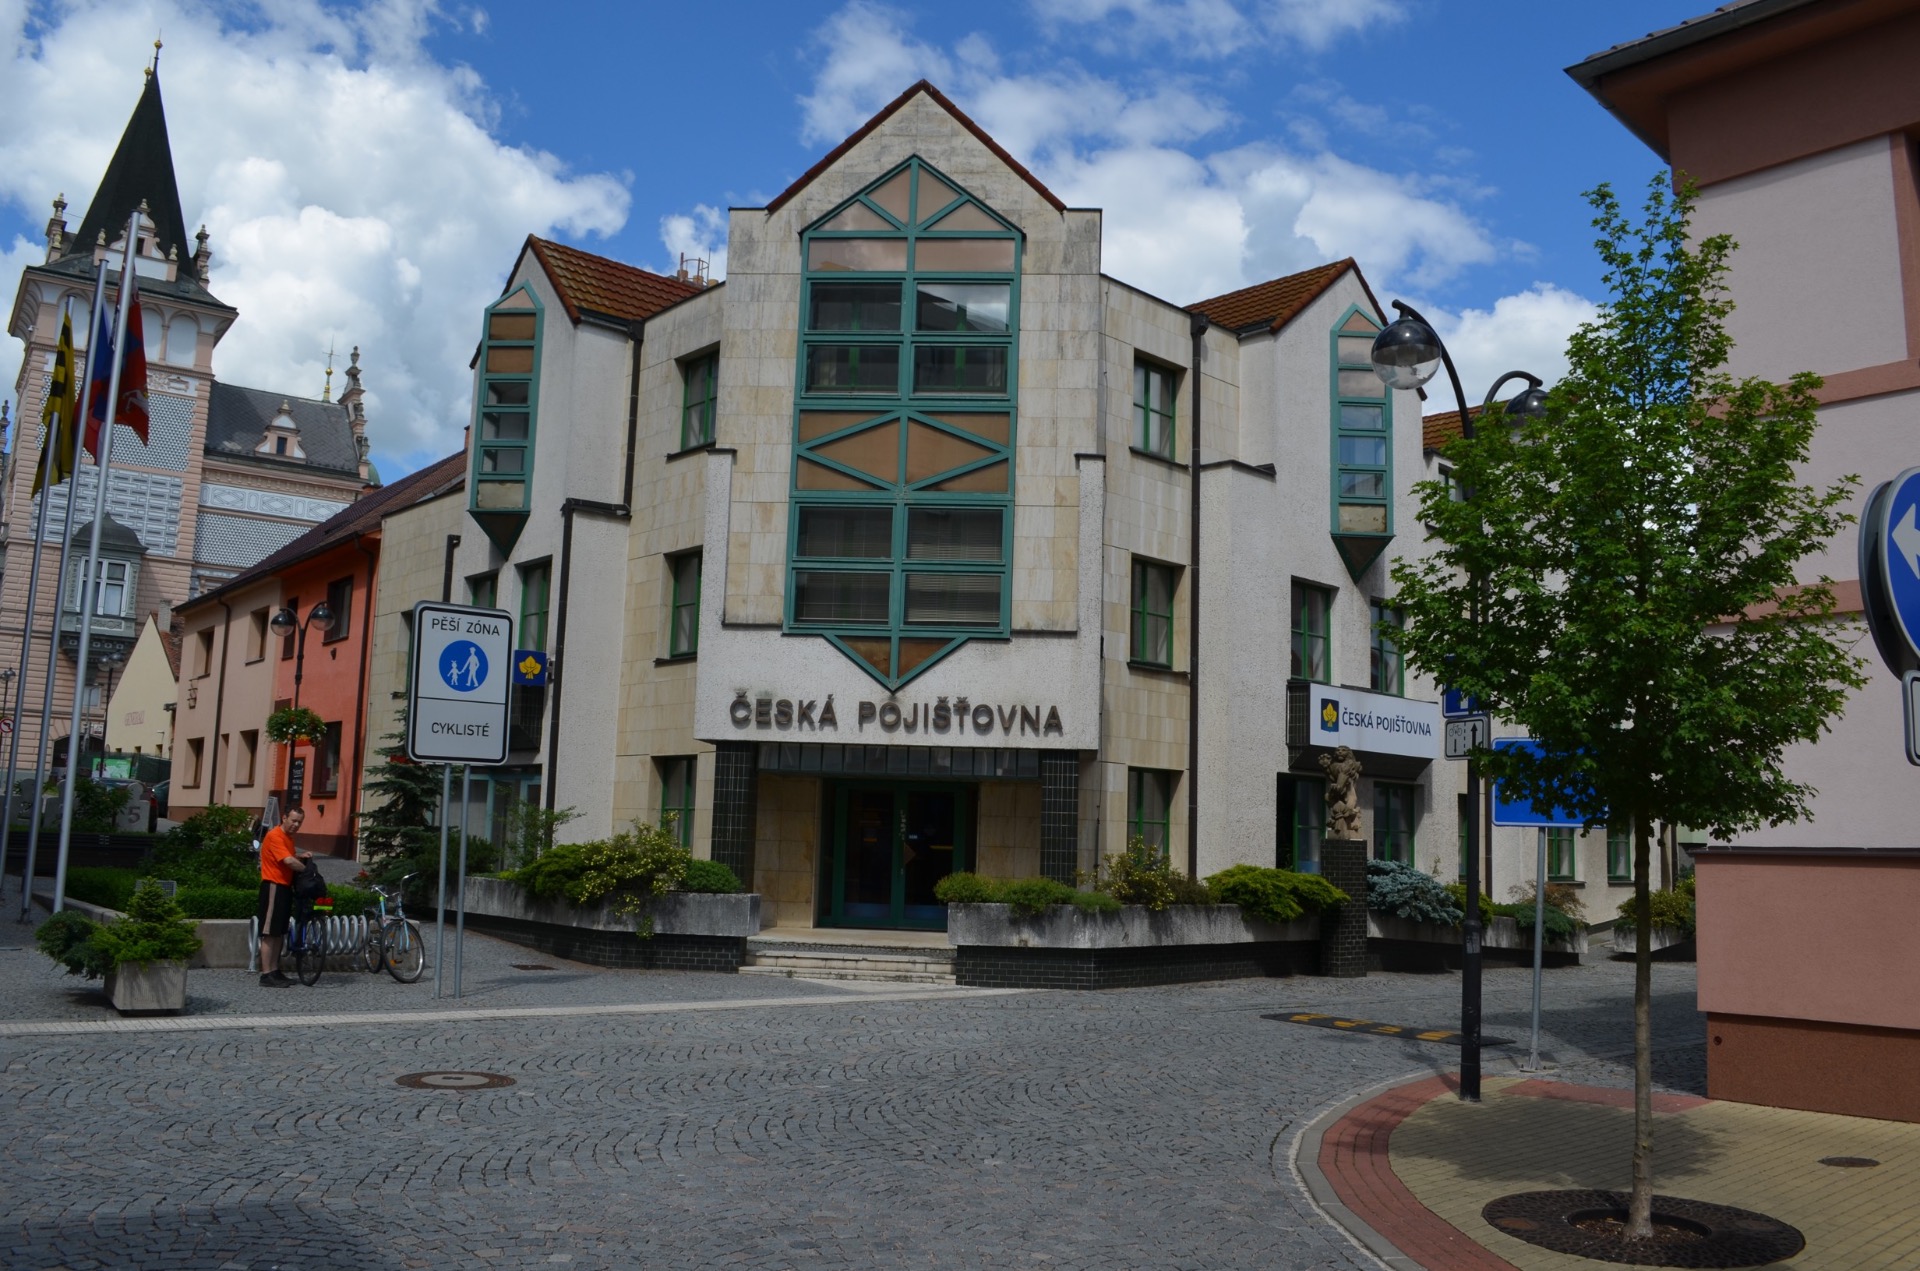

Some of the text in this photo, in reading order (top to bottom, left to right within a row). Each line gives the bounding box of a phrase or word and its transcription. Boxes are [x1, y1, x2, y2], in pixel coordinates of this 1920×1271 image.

[431, 616, 501, 636] PĚŠÍ ZÓNA
[729, 690, 1064, 731] ČESKÁ POJIŠŤOVNA
[431, 722, 490, 737] CYKLISTÉ
[1342, 707, 1432, 737] ČESKÁ POJIŠŤOVNA
[128, 806, 141, 824] 5
